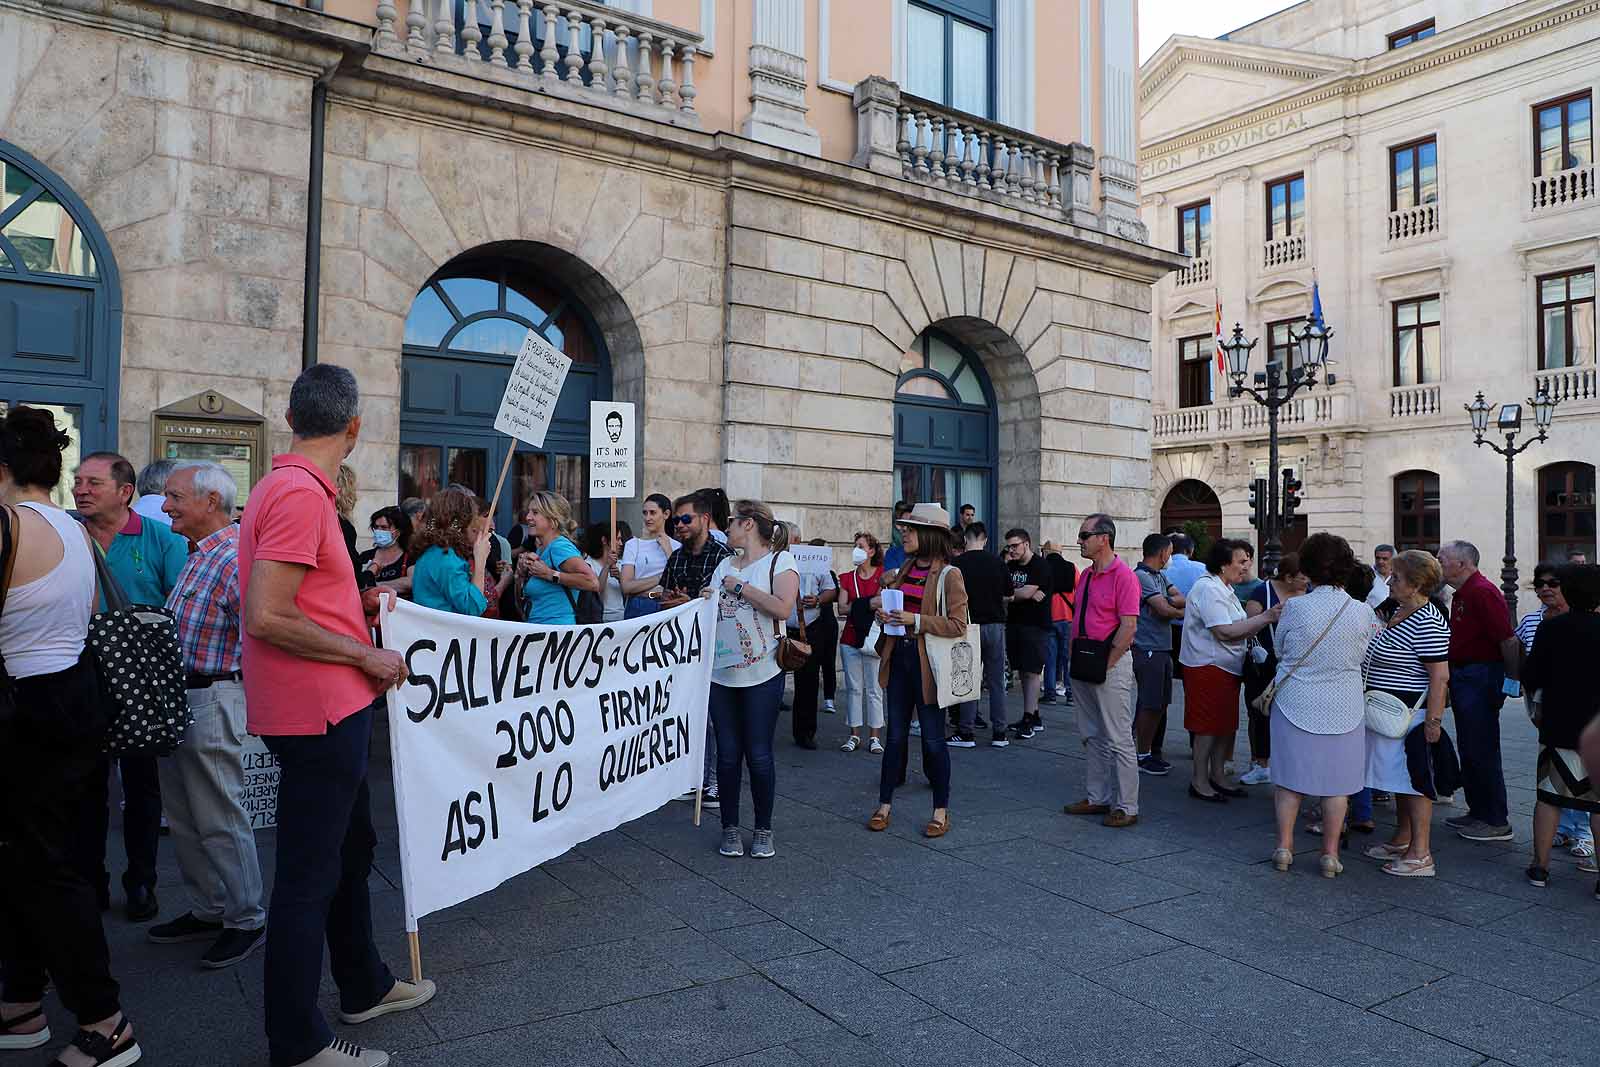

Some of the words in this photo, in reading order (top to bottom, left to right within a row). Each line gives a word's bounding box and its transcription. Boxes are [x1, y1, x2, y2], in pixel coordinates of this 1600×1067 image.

[1198, 111, 1309, 161] PROVINCIAL
[610, 480, 627, 488] LYME
[614, 448, 628, 456] NOT
[406, 628, 614, 723] SALVEMOS
[608, 646, 621, 667] a
[622, 612, 702, 675] CARLA
[496, 700, 575, 769] 2000
[599, 674, 673, 734] FIRMAS
[441, 782, 499, 862] ASI
[532, 761, 573, 824] LO
[599, 712, 690, 792] QUIEREN
